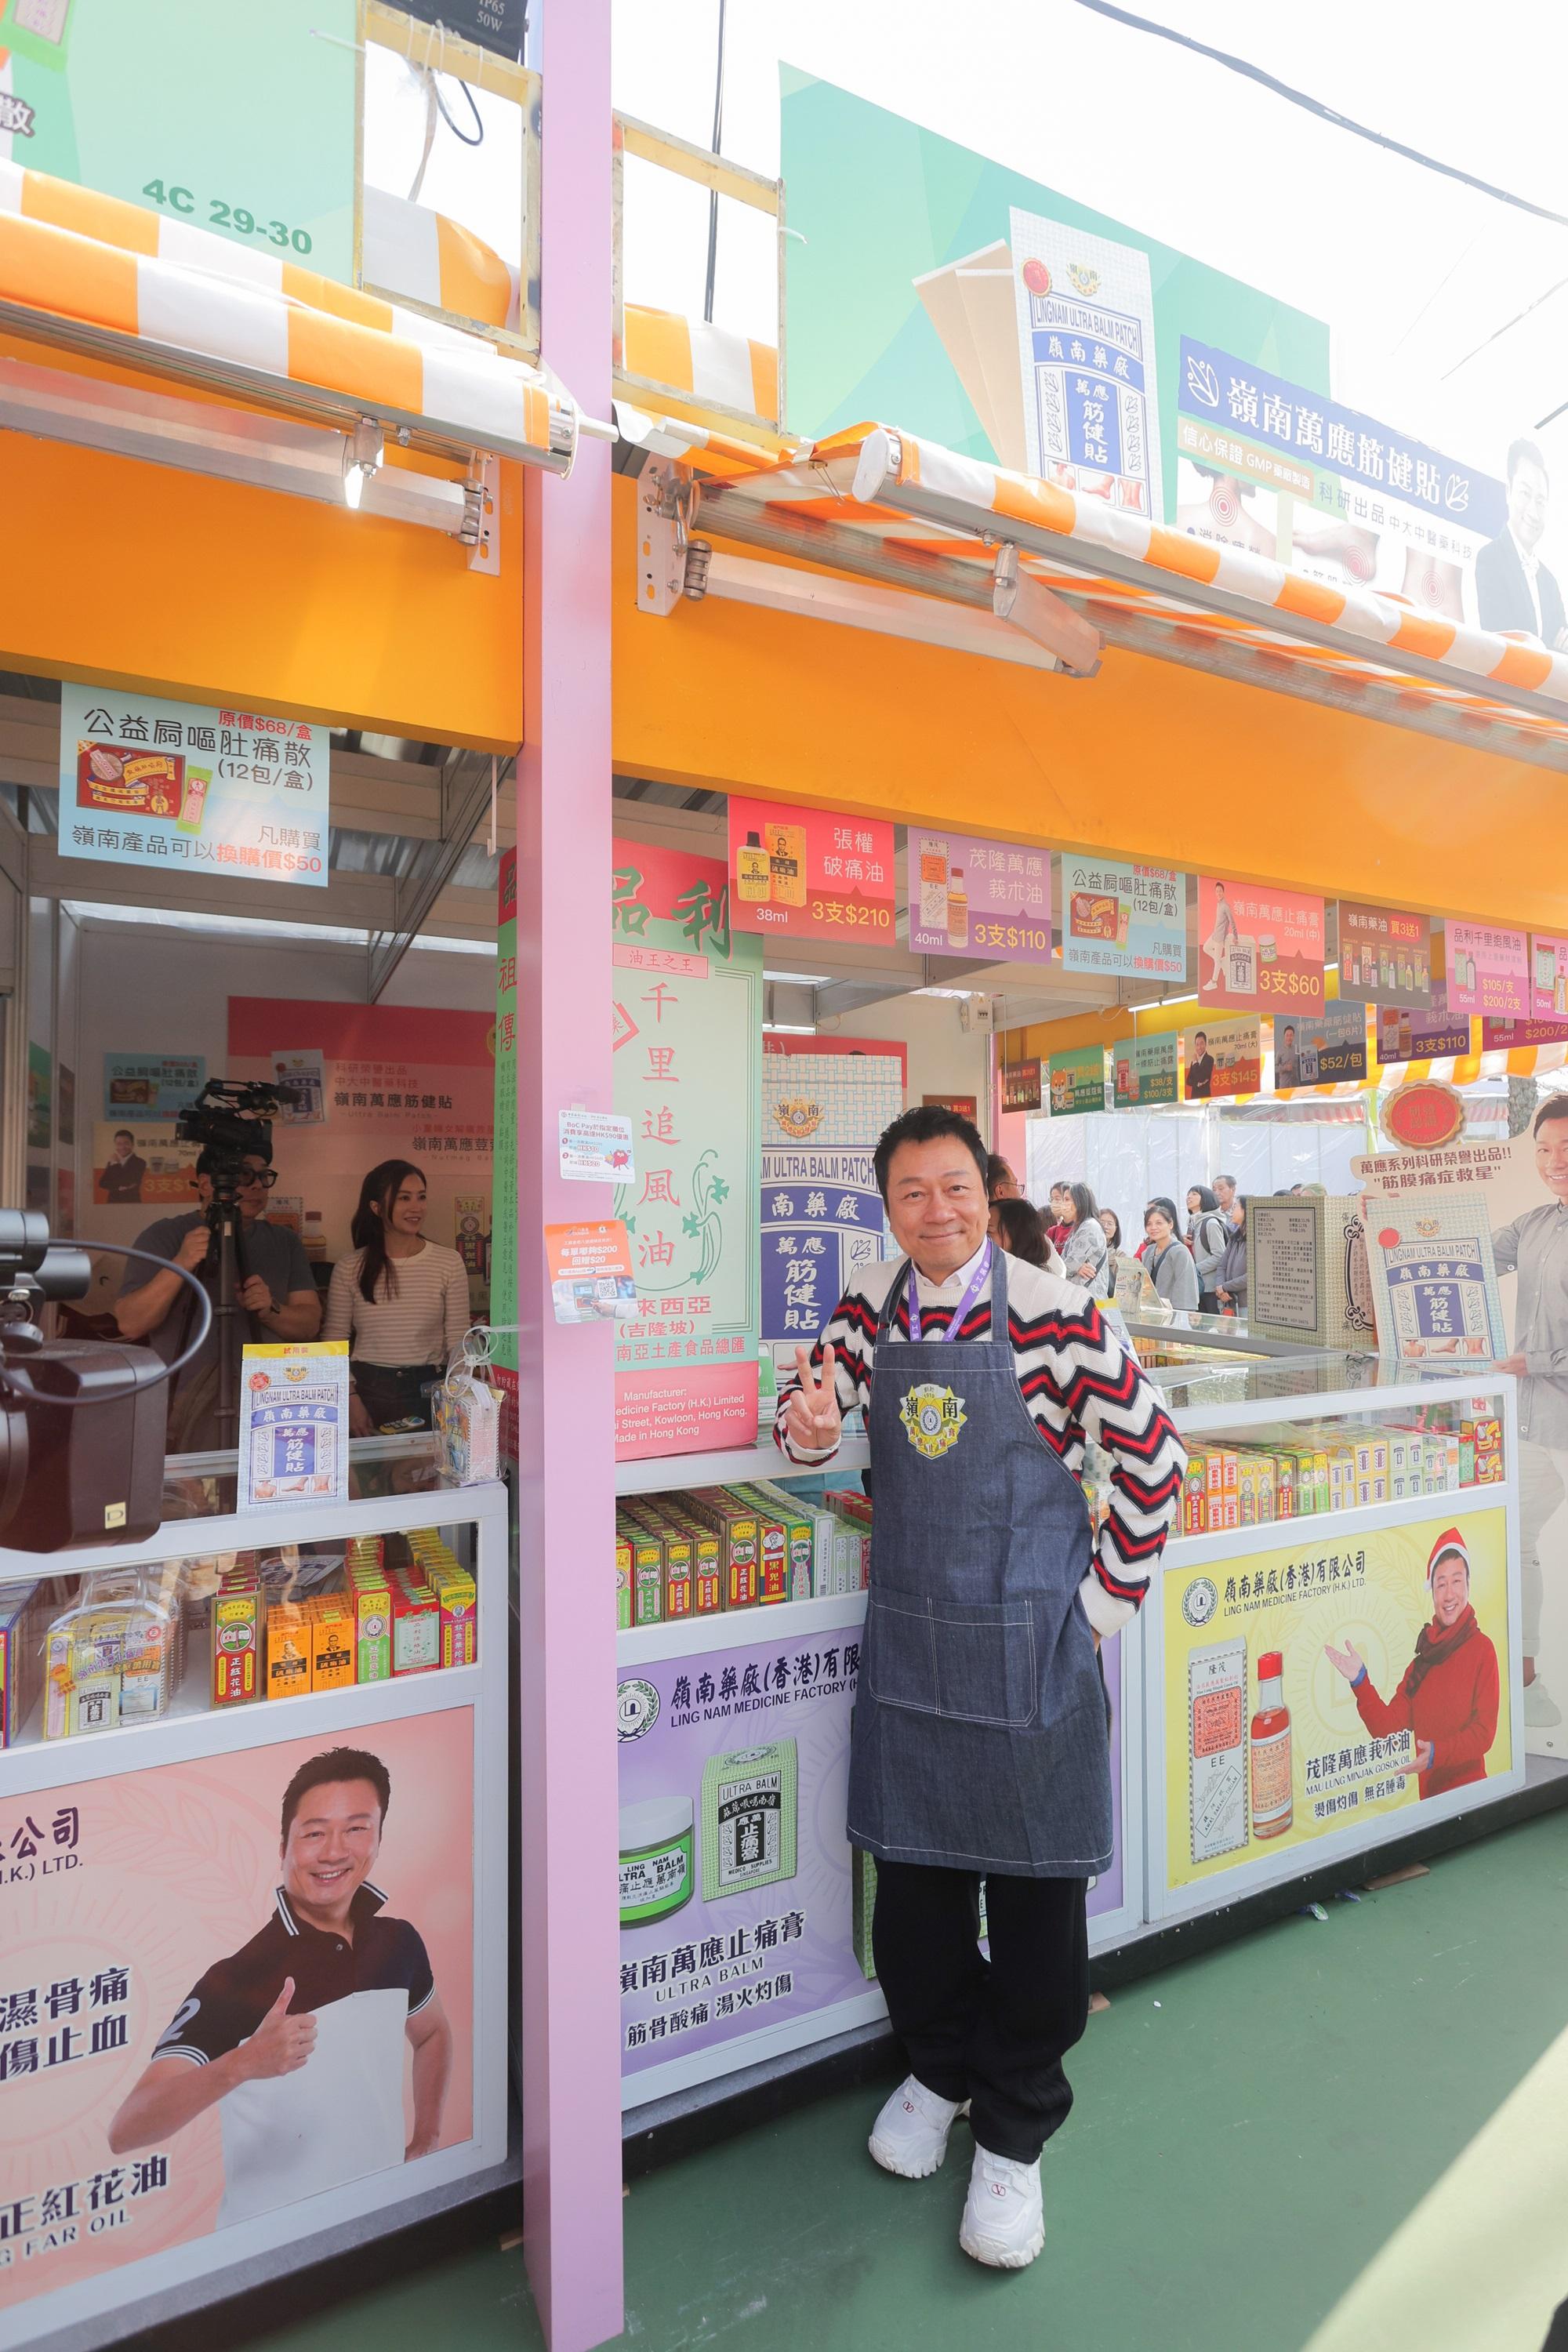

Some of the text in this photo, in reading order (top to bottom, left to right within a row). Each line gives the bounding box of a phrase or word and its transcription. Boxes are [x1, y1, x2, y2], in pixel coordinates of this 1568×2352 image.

[477, 10, 503, 32] 50W
[142, 179, 313, 255] 4C 29-30
[1036, 298, 1137, 351] LINGNAM ULTRA BALM PATCH
[1048, 335, 1131, 380] 嶺南藥廠
[1075, 378, 1110, 401] 萬應
[1083, 399, 1109, 464] 筋健貼
[1226, 376, 1441, 506] 嶺南萬應筋健貼
[1182, 425, 1244, 467] 信心保證
[1318, 481, 1385, 526] 科研出品
[218, 710, 313, 741] 原價$68/盒
[217, 759, 314, 792] (12包/盒)
[71, 824, 322, 873] 嶺南產品可以換購價$50
[257, 826, 321, 851] 凡購買
[833, 827, 874, 854] 張權
[823, 855, 884, 884] 破痛油
[969, 848, 1044, 877] 茂隆萬應
[756, 908, 788, 923] 38ml
[811, 900, 890, 928] 3支$210
[1134, 901, 1178, 917] (12包/盒)
[1233, 900, 1320, 928] 嶺南萬應止痛膏
[915, 932, 943, 947] 40ml
[975, 924, 1046, 950] 3支$110
[1283, 926, 1305, 938] 20ml
[1390, 920, 1420, 938] 買3送1
[1454, 927, 1522, 951] 品利千里追風油
[1152, 942, 1182, 958] 凡購買
[1260, 970, 1320, 996] 3支$60
[1483, 979, 1514, 994] $105/支
[1459, 994, 1475, 1004] 55ml
[1483, 995, 1522, 1011] $200/2支
[1536, 999, 1552, 1009] 50ml
[1416, 1035, 1466, 1054] 3支$110
[1494, 1033, 1514, 1043] 55ml
[1320, 1052, 1363, 1071] $52/包
[1213, 1069, 1258, 1087] 3支$145
[334, 1091, 453, 1109] 嶺南萬應筋健貼
[636, 982, 682, 1269] 千里追風油
[774, 1156, 808, 1178] ULTRA
[809, 1156, 839, 1180] BALM
[841, 1156, 875, 1186] PATCH
[771, 1191, 861, 1221] 南藥廠
[775, 1236, 827, 1255] 萬應
[1417, 1246, 1437, 1259] ULTRA
[1438, 1245, 1455, 1258] BALM
[1456, 1243, 1475, 1260] PATCH
[783, 1258, 822, 1330] 筋健貼
[1430, 1296, 1454, 1334] 筋健貼
[619, 1319, 696, 1339] (吉隆坡)
[282, 1389, 299, 1402] ULTRA
[300, 1388, 316, 1401] BALM
[317, 1387, 335, 1402] PATCH
[624, 1388, 687, 1402] Manufacturer:
[652, 1401, 686, 1414] Factory
[688, 1397, 712, 1410] (H.K.)
[713, 1394, 745, 1406] Limited
[621, 1417, 652, 1429] Street,
[655, 1414, 696, 1425] Kowloon,
[698, 1410, 721, 1421] Hong
[723, 1407, 747, 1419] Kong.
[639, 1431, 648, 1440] in
[649, 1428, 674, 1440] Hong
[677, 1425, 700, 1437] Kong
[285, 1439, 305, 1473] 筋健貼
[1223, 1550, 1366, 1603] 嶺南藥廠(香港)有限公司
[1224, 1577, 1367, 1617] LING NAM MEDICINE FACTORY (H.K.) LTD.
[230, 1657, 242, 1698] 正紅花油
[670, 1642, 861, 1711] 嶺南藥廠(香港)有限
[671, 1711, 700, 1728] LING
[703, 1704, 731, 1721] NAM
[734, 1693, 791, 1714] MEDICINE
[794, 1680, 848, 1701] FACTORY
[722, 1775, 778, 1801] ULTRA BALM
[1305, 1754, 1411, 1797] MAU LUNG MINJAK GOSOK OIL
[0, 1806, 78, 1861] 公司
[43, 1853, 83, 1875] LTD.
[627, 1856, 669, 1873] LING NAM
[657, 1855, 684, 1874] BALM
[750, 1859, 772, 1869] SUPPLIES
[620, 1911, 805, 1995] 嶺南萬應止痛膏
[655, 1956, 764, 2002] ULTRA BALM
[0, 1967, 131, 2032] 濕骨痛
[626, 1973, 793, 2049] 筋骨酸痛 湯火灼傷
[0, 2013, 129, 2081] 傷止血
[0, 2155, 169, 2240] 正紅花油
[25, 2225, 77, 2258] FAR
[89, 2209, 131, 2236] OIL
